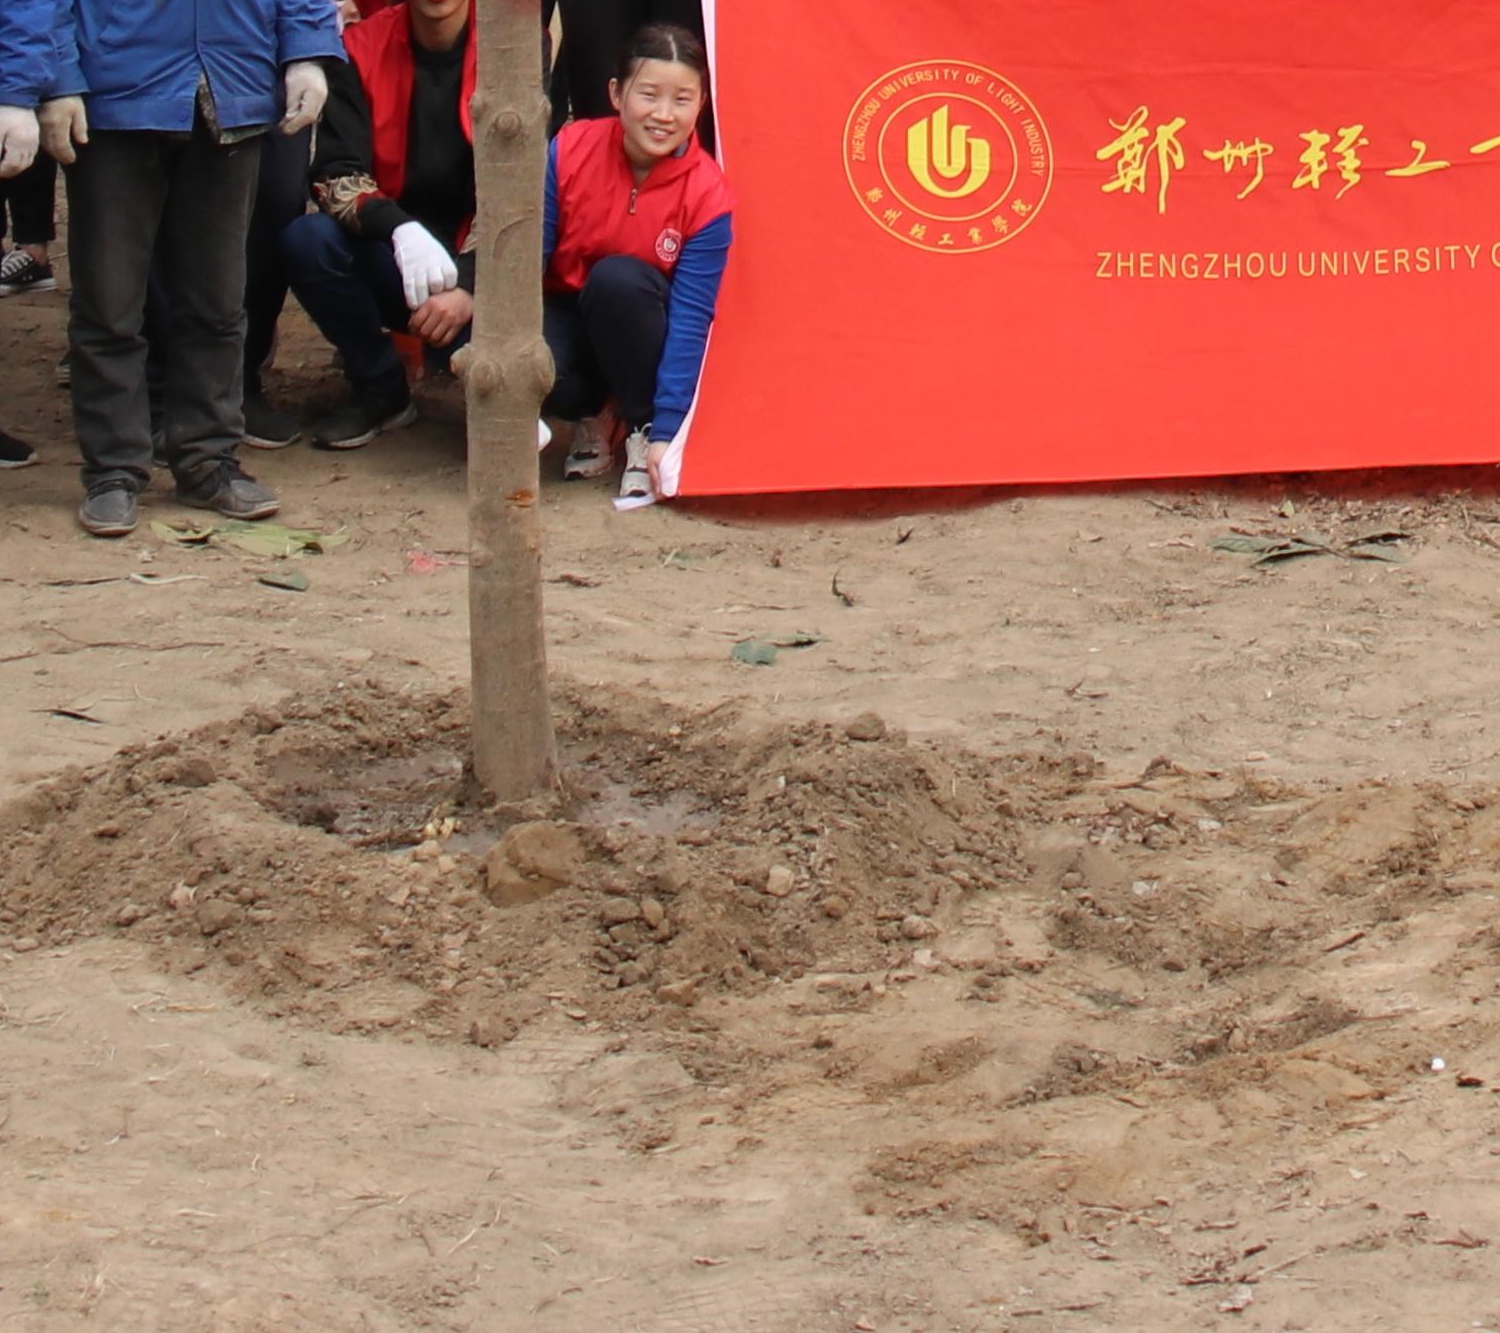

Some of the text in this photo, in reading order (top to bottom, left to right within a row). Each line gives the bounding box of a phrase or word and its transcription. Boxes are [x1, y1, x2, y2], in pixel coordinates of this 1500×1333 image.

[852, 68, 1046, 178] ZHENGZHOU UNIVERSITY OF LIGHT INDUSTRY
[1095, 251, 1288, 279] ZHENGZHOU
[1297, 243, 1482, 278] UNIVERSITY
